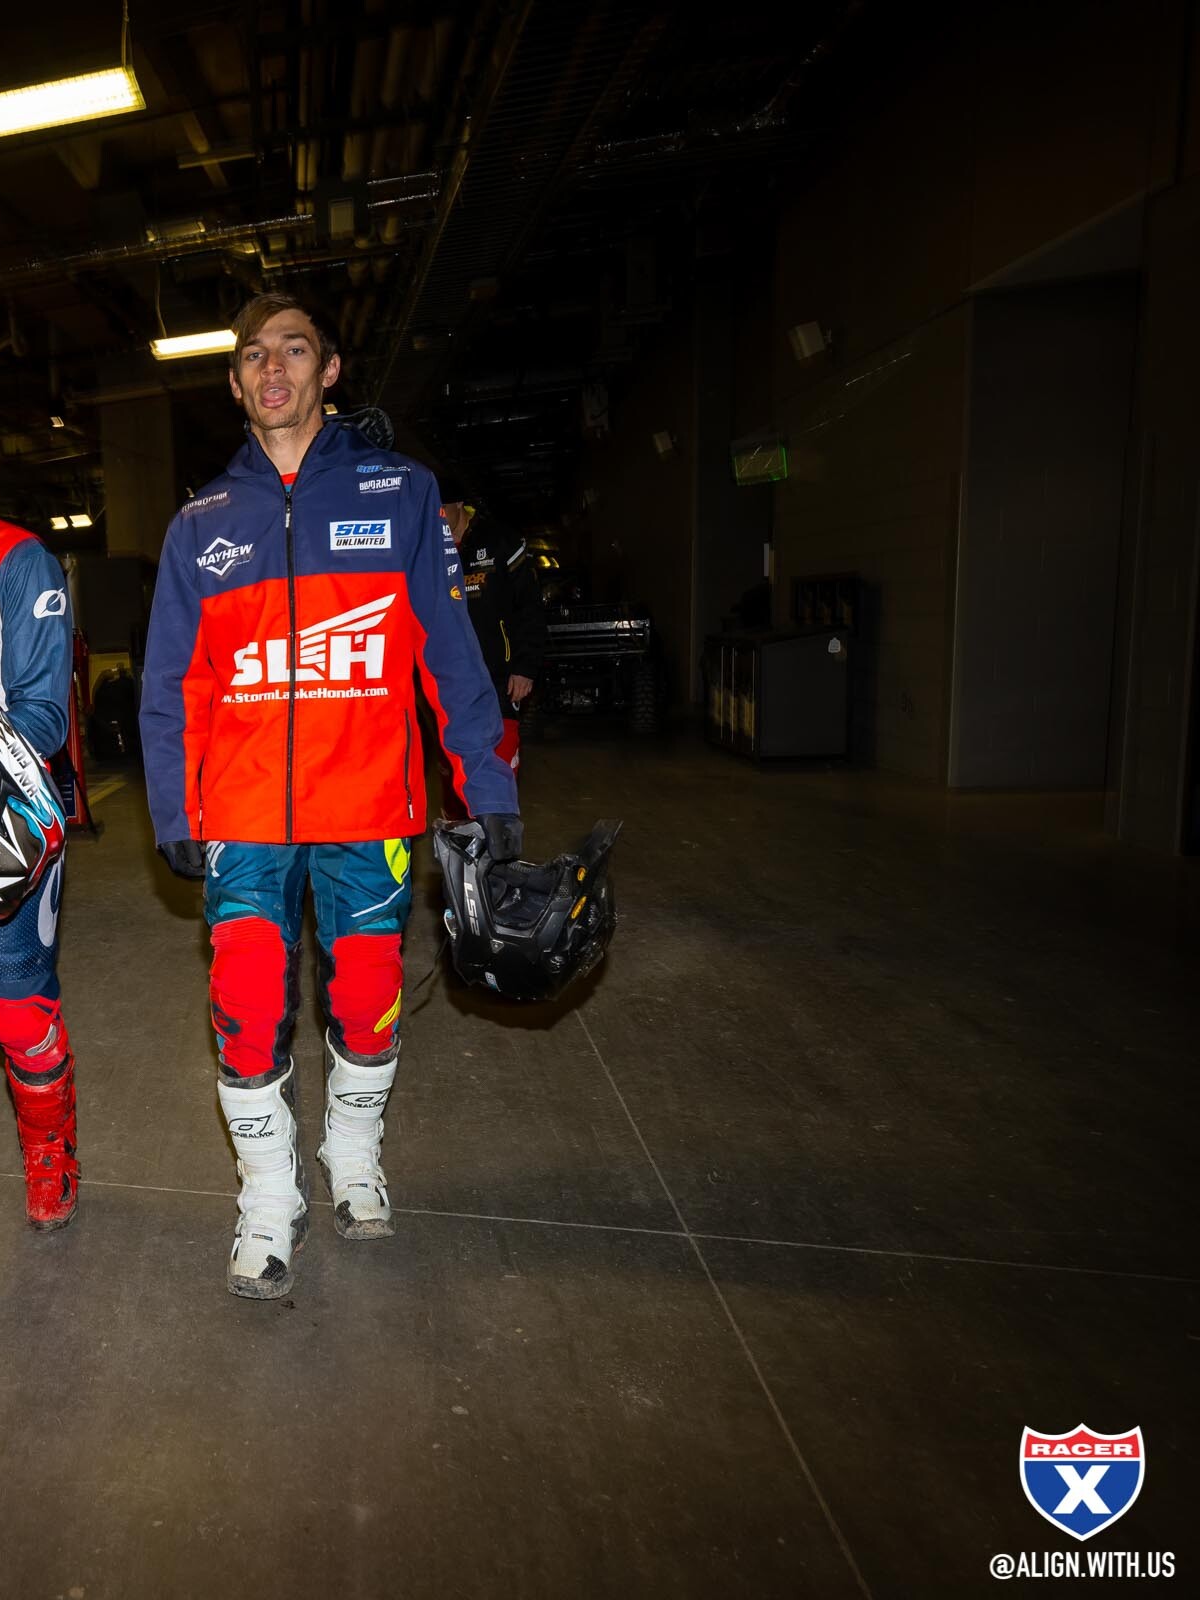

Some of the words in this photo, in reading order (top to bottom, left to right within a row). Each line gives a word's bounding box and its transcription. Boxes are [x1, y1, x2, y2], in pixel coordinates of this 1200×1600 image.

[335, 523, 386, 535] SGB
[336, 537, 385, 547] UNLIMITED
[196, 543, 253, 567] MAYHEW
[230, 634, 386, 687] SLH
[463, 882, 481, 937] LS2
